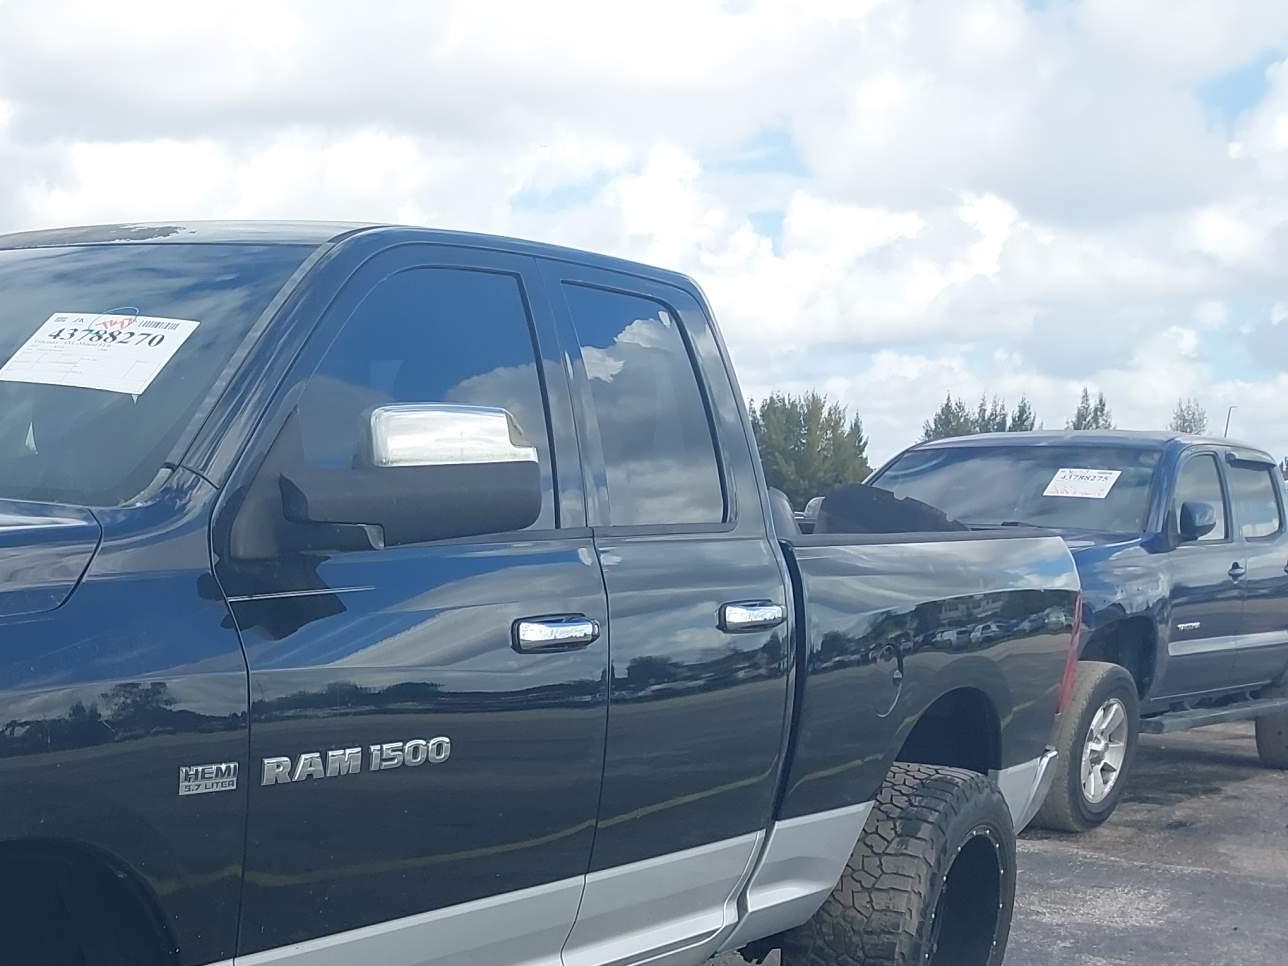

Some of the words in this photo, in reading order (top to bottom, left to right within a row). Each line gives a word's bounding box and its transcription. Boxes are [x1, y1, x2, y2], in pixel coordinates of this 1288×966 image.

[48, 327, 165, 348] 43788270
[261, 747, 363, 786] RAM
[369, 736, 452, 772] 1500
[182, 762, 238, 783] HEMI
[184, 782, 202, 793] 5.7
[204, 780, 236, 792] LITER
